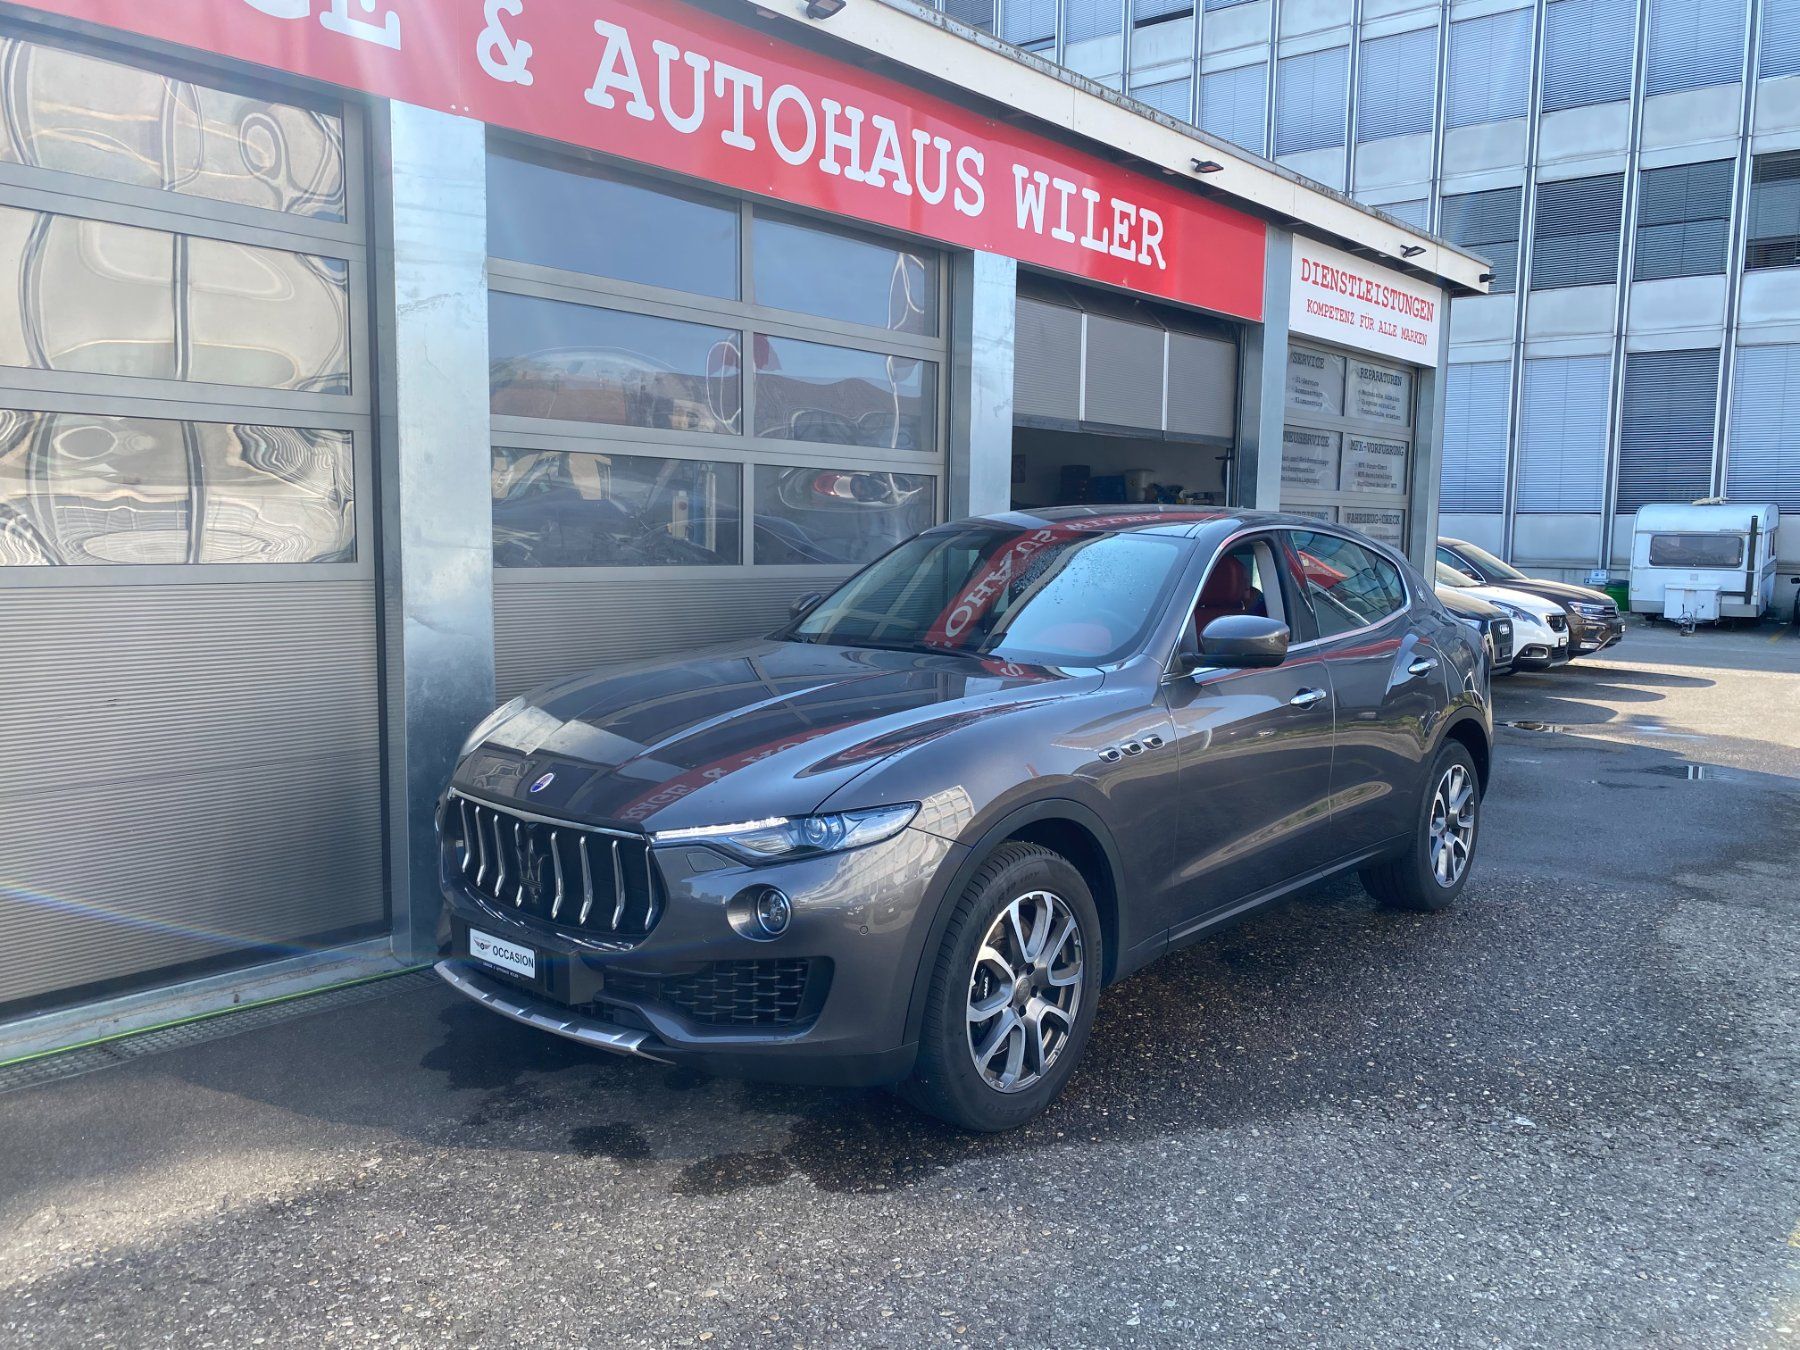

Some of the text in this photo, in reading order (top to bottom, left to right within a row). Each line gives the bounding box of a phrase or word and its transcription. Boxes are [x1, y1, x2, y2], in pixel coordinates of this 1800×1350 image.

[477, 0, 534, 86] &
[584, 19, 985, 217] AUTOHAUS
[1012, 163, 1167, 270] WILER
[1301, 258, 1435, 322] DIENSTLEISTUNGEN
[1307, 299, 1428, 345] KOMPETENZ FÜR ALLE MARKEN
[1292, 352, 1325, 369] SERVICE
[1360, 367, 1403, 387] REPARATUREN
[493, 945, 534, 969] OCCASION
